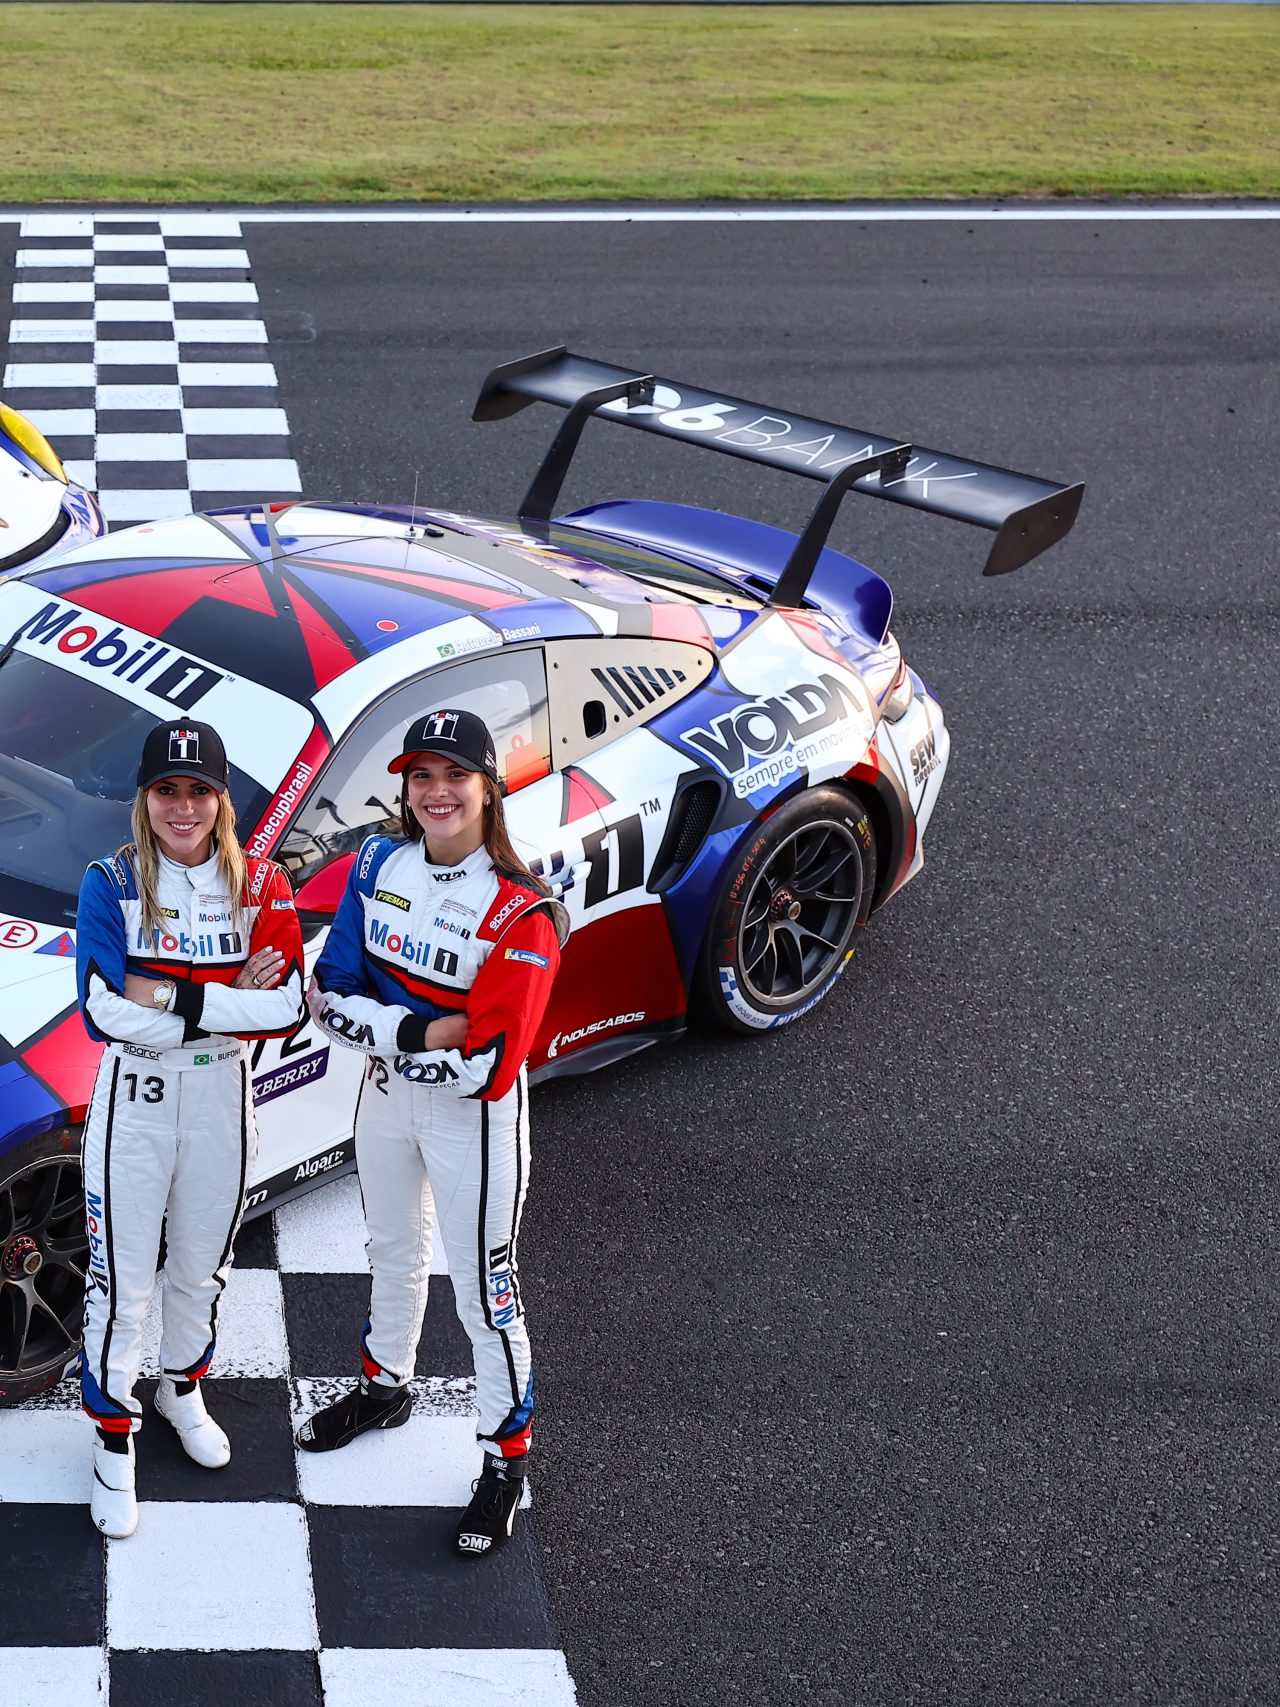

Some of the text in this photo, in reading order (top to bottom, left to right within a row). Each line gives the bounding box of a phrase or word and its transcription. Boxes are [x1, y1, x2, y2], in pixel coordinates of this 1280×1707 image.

[715, 416, 978, 499] BANK
[502, 623, 542, 641] Bassani
[20, 602, 235, 700] Mobil 1 TM
[170, 729, 199, 739] Mobil
[434, 718, 445, 735] 1
[687, 674, 865, 774] VOLDA
[177, 739, 188, 758] 1
[910, 730, 936, 776] SEW
[738, 755, 795, 795] sempre
[797, 744, 819, 763] em
[249, 761, 313, 858] schecupbrasil
[600, 798, 661, 895] 1 TM
[199, 912, 226, 923] Mobil
[376, 891, 410, 910] FREMAX
[489, 894, 525, 931] sparco
[369, 918, 431, 966] Mobil
[433, 917, 460, 935] Mobil
[560, 1011, 646, 1047] INDUSCABOS
[210, 1048, 241, 1063] L. BUFONI
[123, 1073, 165, 1104] 13
[252, 1056, 324, 1100] KBERRY
[294, 1152, 335, 1181] Algar
[87, 1190, 105, 1270] Mobil
[488, 1267, 516, 1328] Mobil
[491, 1459, 508, 1469] OMP
[458, 1534, 492, 1551] OMP
